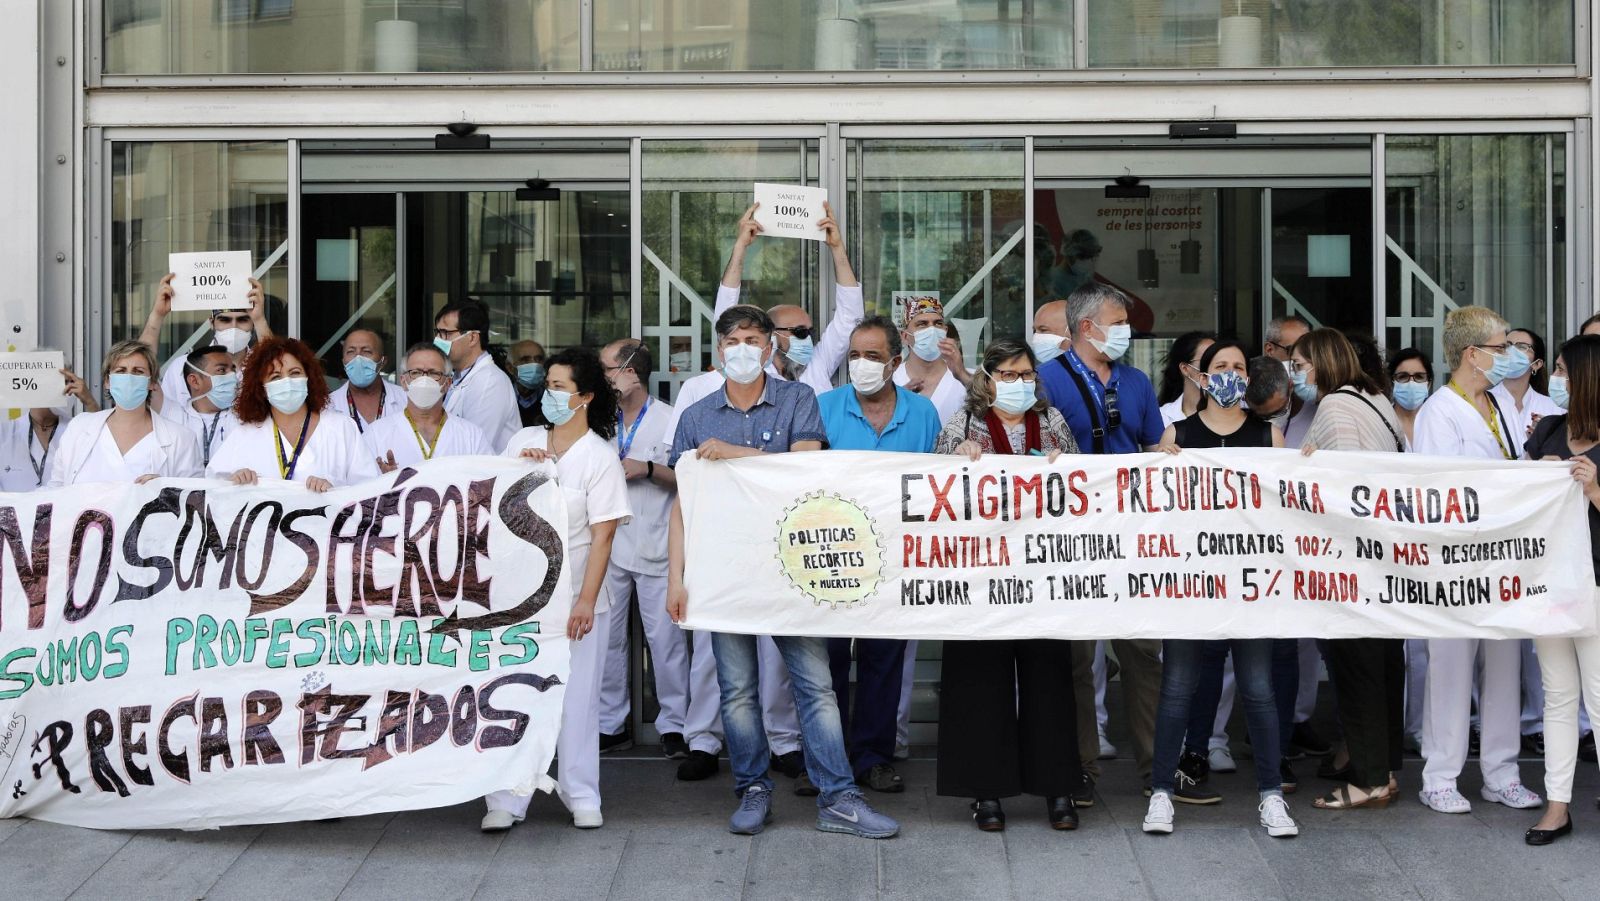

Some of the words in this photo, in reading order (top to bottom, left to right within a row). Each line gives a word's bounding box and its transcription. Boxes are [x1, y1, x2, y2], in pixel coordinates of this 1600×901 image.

[777, 193, 805, 201] SANITAT
[774, 205, 809, 218] 100%
[1097, 206, 1144, 219] sempre
[1147, 205, 1159, 216] al
[1162, 206, 1202, 216] costat
[1105, 220, 1122, 231] de
[1125, 219, 1142, 231] les
[1145, 220, 1203, 232] persones
[194, 261, 225, 269] SANITAT
[192, 275, 231, 286] 100%
[12, 377, 37, 390] 5%
[1116, 465, 1261, 514] PRESUPUESTO
[1279, 479, 1325, 514] PARA
[1351, 485, 1480, 524] SANIDAD
[788, 527, 856, 546] POLITICAS
[0, 502, 114, 632] NO
[109, 487, 328, 618] SOMOS
[325, 466, 564, 633] HÉROES
[820, 543, 831, 551] DE
[903, 533, 1010, 568] PLANTILLA
[1024, 533, 1126, 564] ESTRUCTURAL
[1197, 531, 1285, 557] CONTRATOS
[1356, 536, 1383, 560] NO
[1393, 543, 1429, 566] MAS
[1442, 537, 1545, 564] DESCOBERTURAS
[803, 551, 864, 569] RECORTES
[820, 578, 861, 589] MUERTES
[901, 578, 971, 606] MEJORAR
[989, 575, 1033, 604] RATIOS
[1241, 567, 1283, 602] 5%
[1499, 575, 1521, 602] 60
[1526, 583, 1548, 597] AÑOS
[0, 625, 134, 699] SOMOS
[165, 613, 541, 676] PROFESIONALES
[30, 673, 565, 798] PRECARIZADOS
